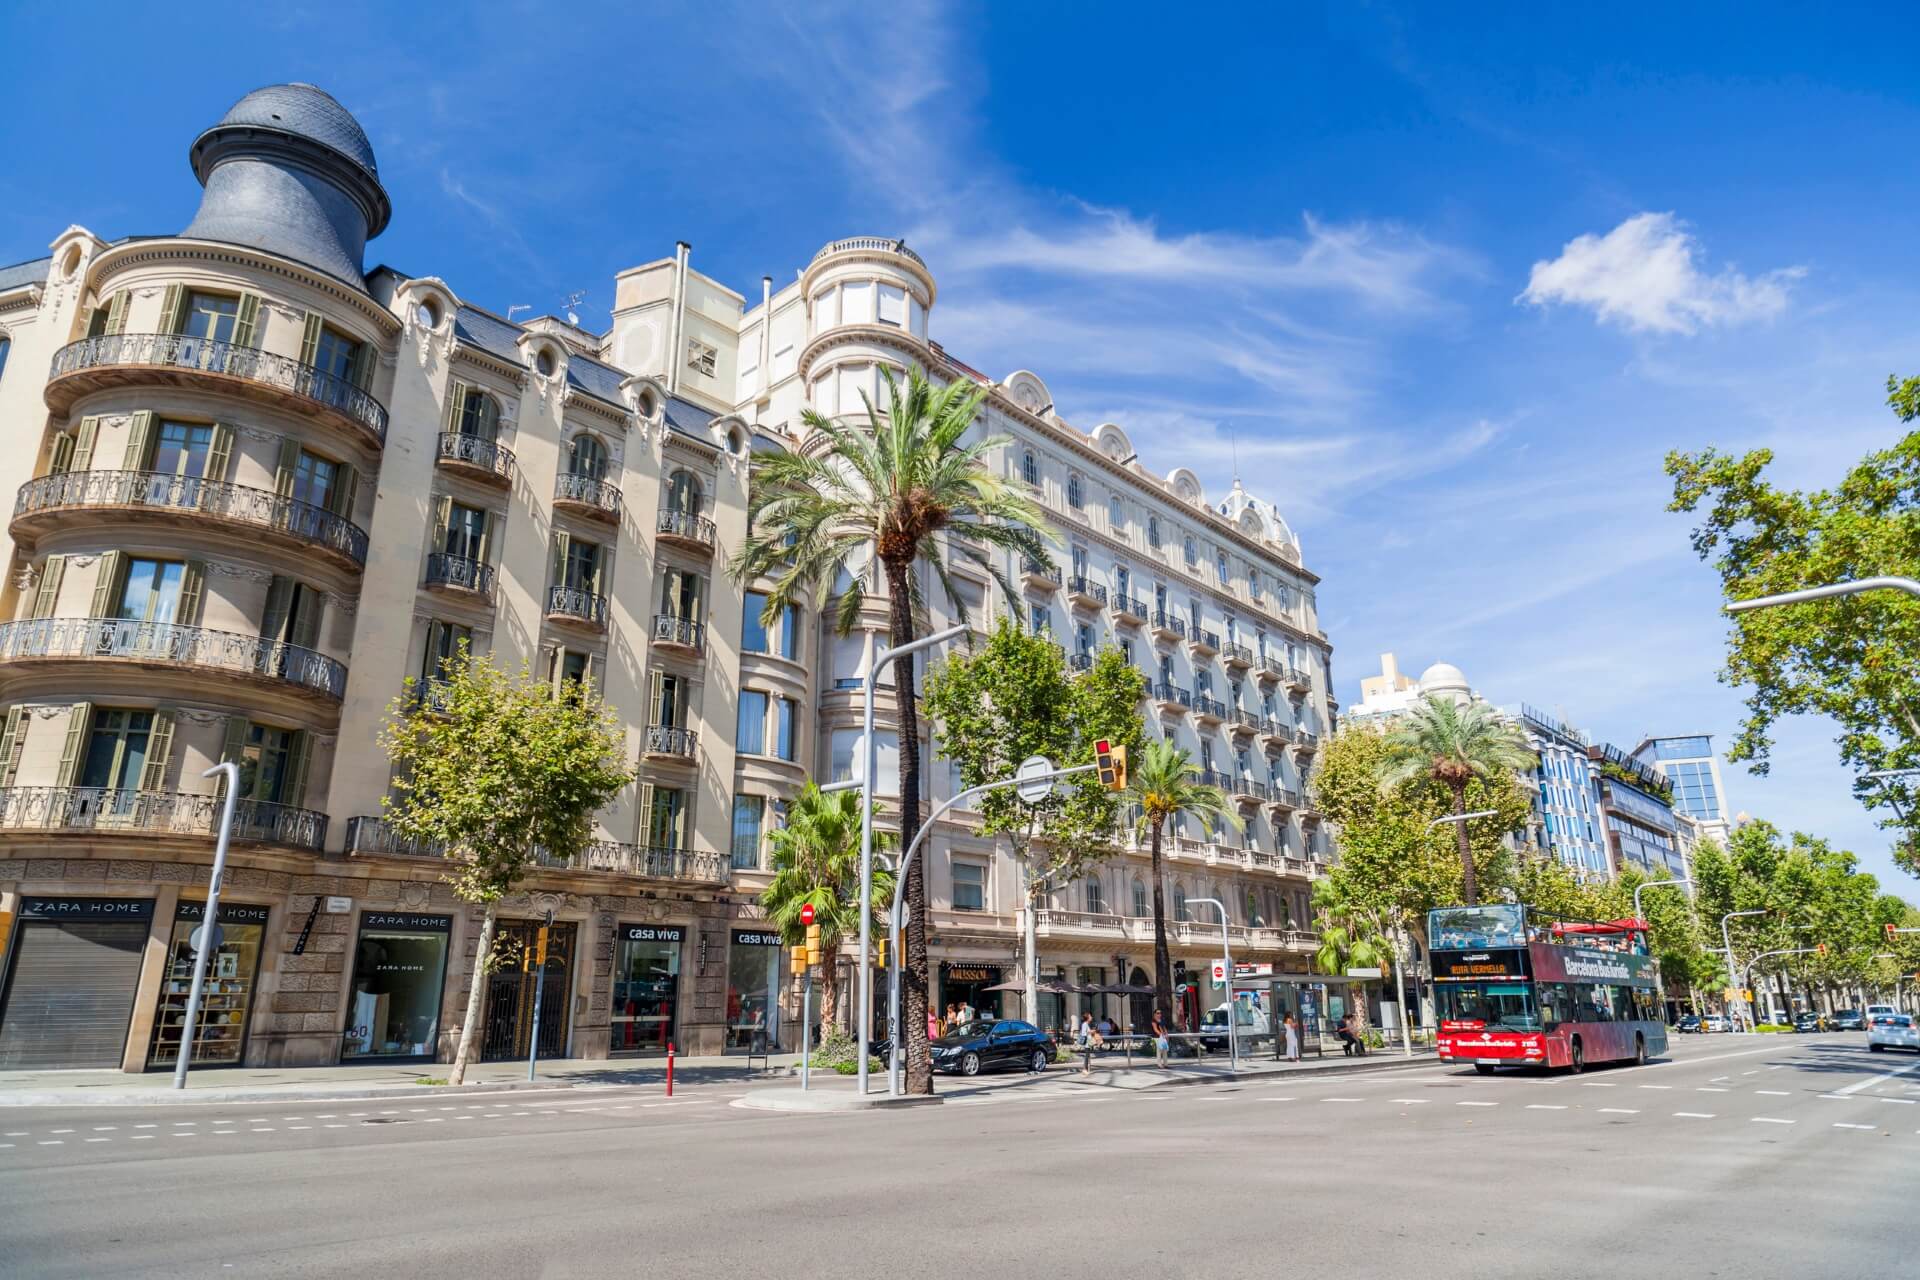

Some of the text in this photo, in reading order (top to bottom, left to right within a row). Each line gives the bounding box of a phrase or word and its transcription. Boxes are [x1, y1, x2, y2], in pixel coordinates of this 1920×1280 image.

[33, 902, 141, 913] ZARA HOME
[227, 908, 267, 919] HOME
[368, 916, 447, 927] ZARA HOME
[629, 927, 680, 941] casa viva
[738, 932, 782, 945] casa viva
